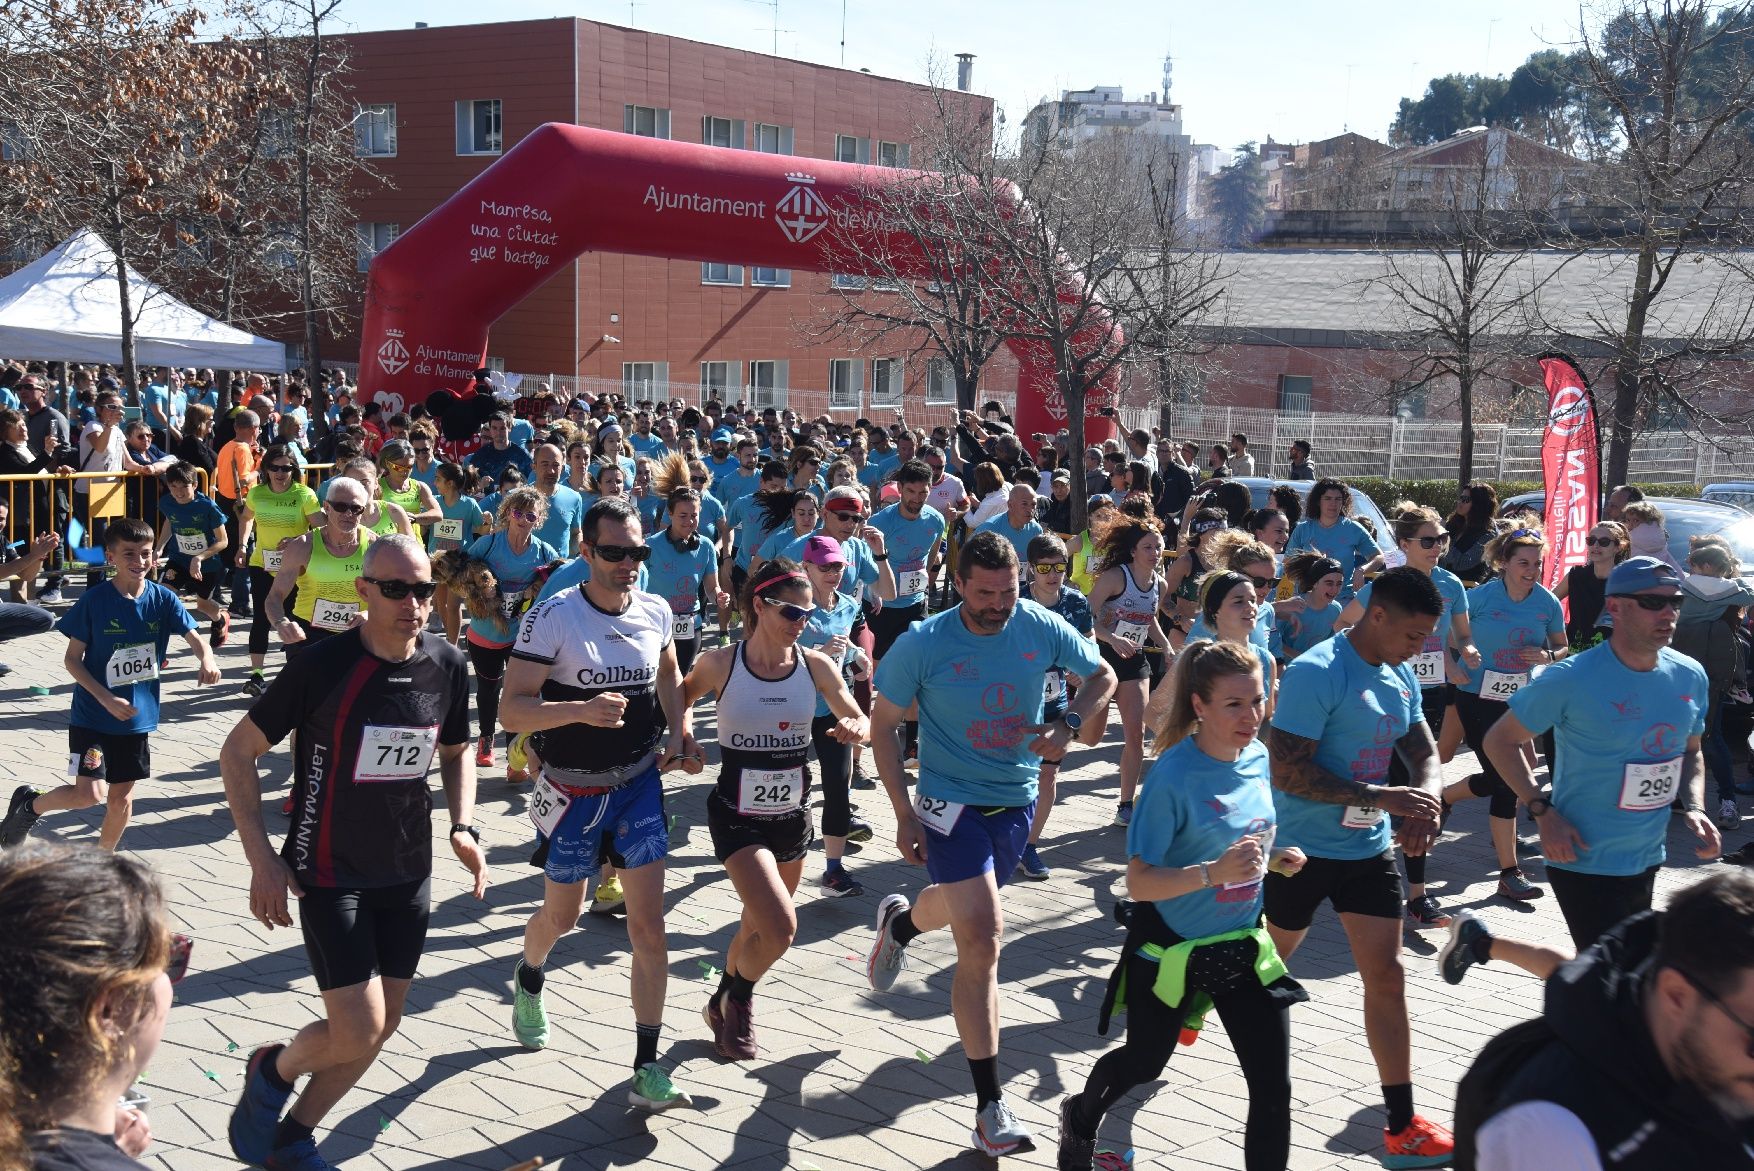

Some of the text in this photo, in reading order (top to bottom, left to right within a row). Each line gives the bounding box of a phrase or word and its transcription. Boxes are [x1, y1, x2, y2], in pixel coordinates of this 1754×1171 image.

[643, 184, 766, 220] Ajuntament
[481, 200, 552, 223] Manresa,
[471, 224, 559, 245] una ciutat
[470, 246, 550, 270] que batega
[416, 344, 481, 365] Ajuntament
[414, 361, 475, 380] de Manres
[382, 401, 393, 413] M
[439, 524, 456, 534] 487
[180, 541, 204, 552] 1055
[269, 557, 281, 566] 29
[909, 578, 921, 589] 33
[323, 610, 350, 624] 294
[672, 622, 689, 633] 08
[1122, 631, 1142, 644] 661
[112, 657, 153, 678] 1064
[1411, 662, 1435, 676] 431
[1491, 681, 1519, 695] 429
[730, 733, 806, 749] Collbaix
[376, 745, 421, 766] 712
[753, 784, 792, 802] 242
[1638, 776, 1673, 798] 299
